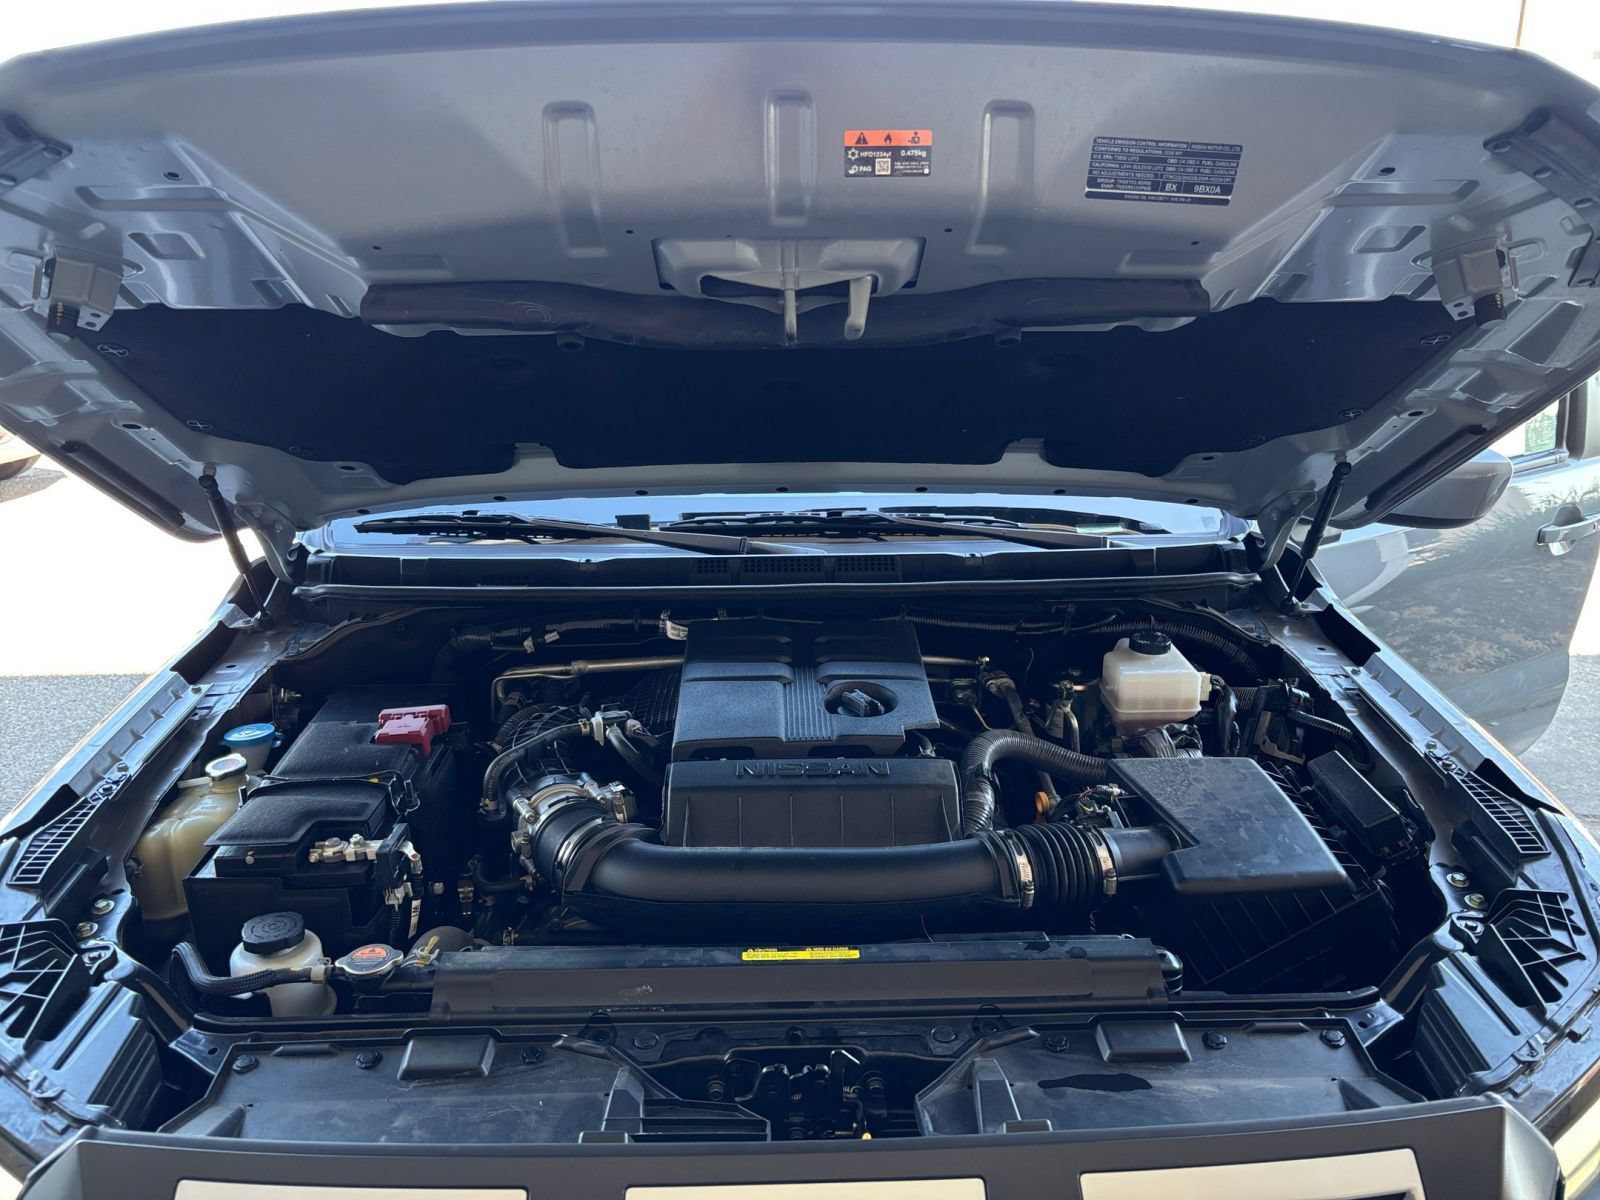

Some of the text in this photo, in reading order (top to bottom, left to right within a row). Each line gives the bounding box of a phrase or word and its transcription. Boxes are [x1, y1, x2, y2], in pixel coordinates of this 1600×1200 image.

[900, 150, 927, 158] 0.475kg
[1165, 183, 1177, 192] BX
[1194, 185, 1221, 194] 9BX0A
[736, 761, 890, 776] NISSAN
